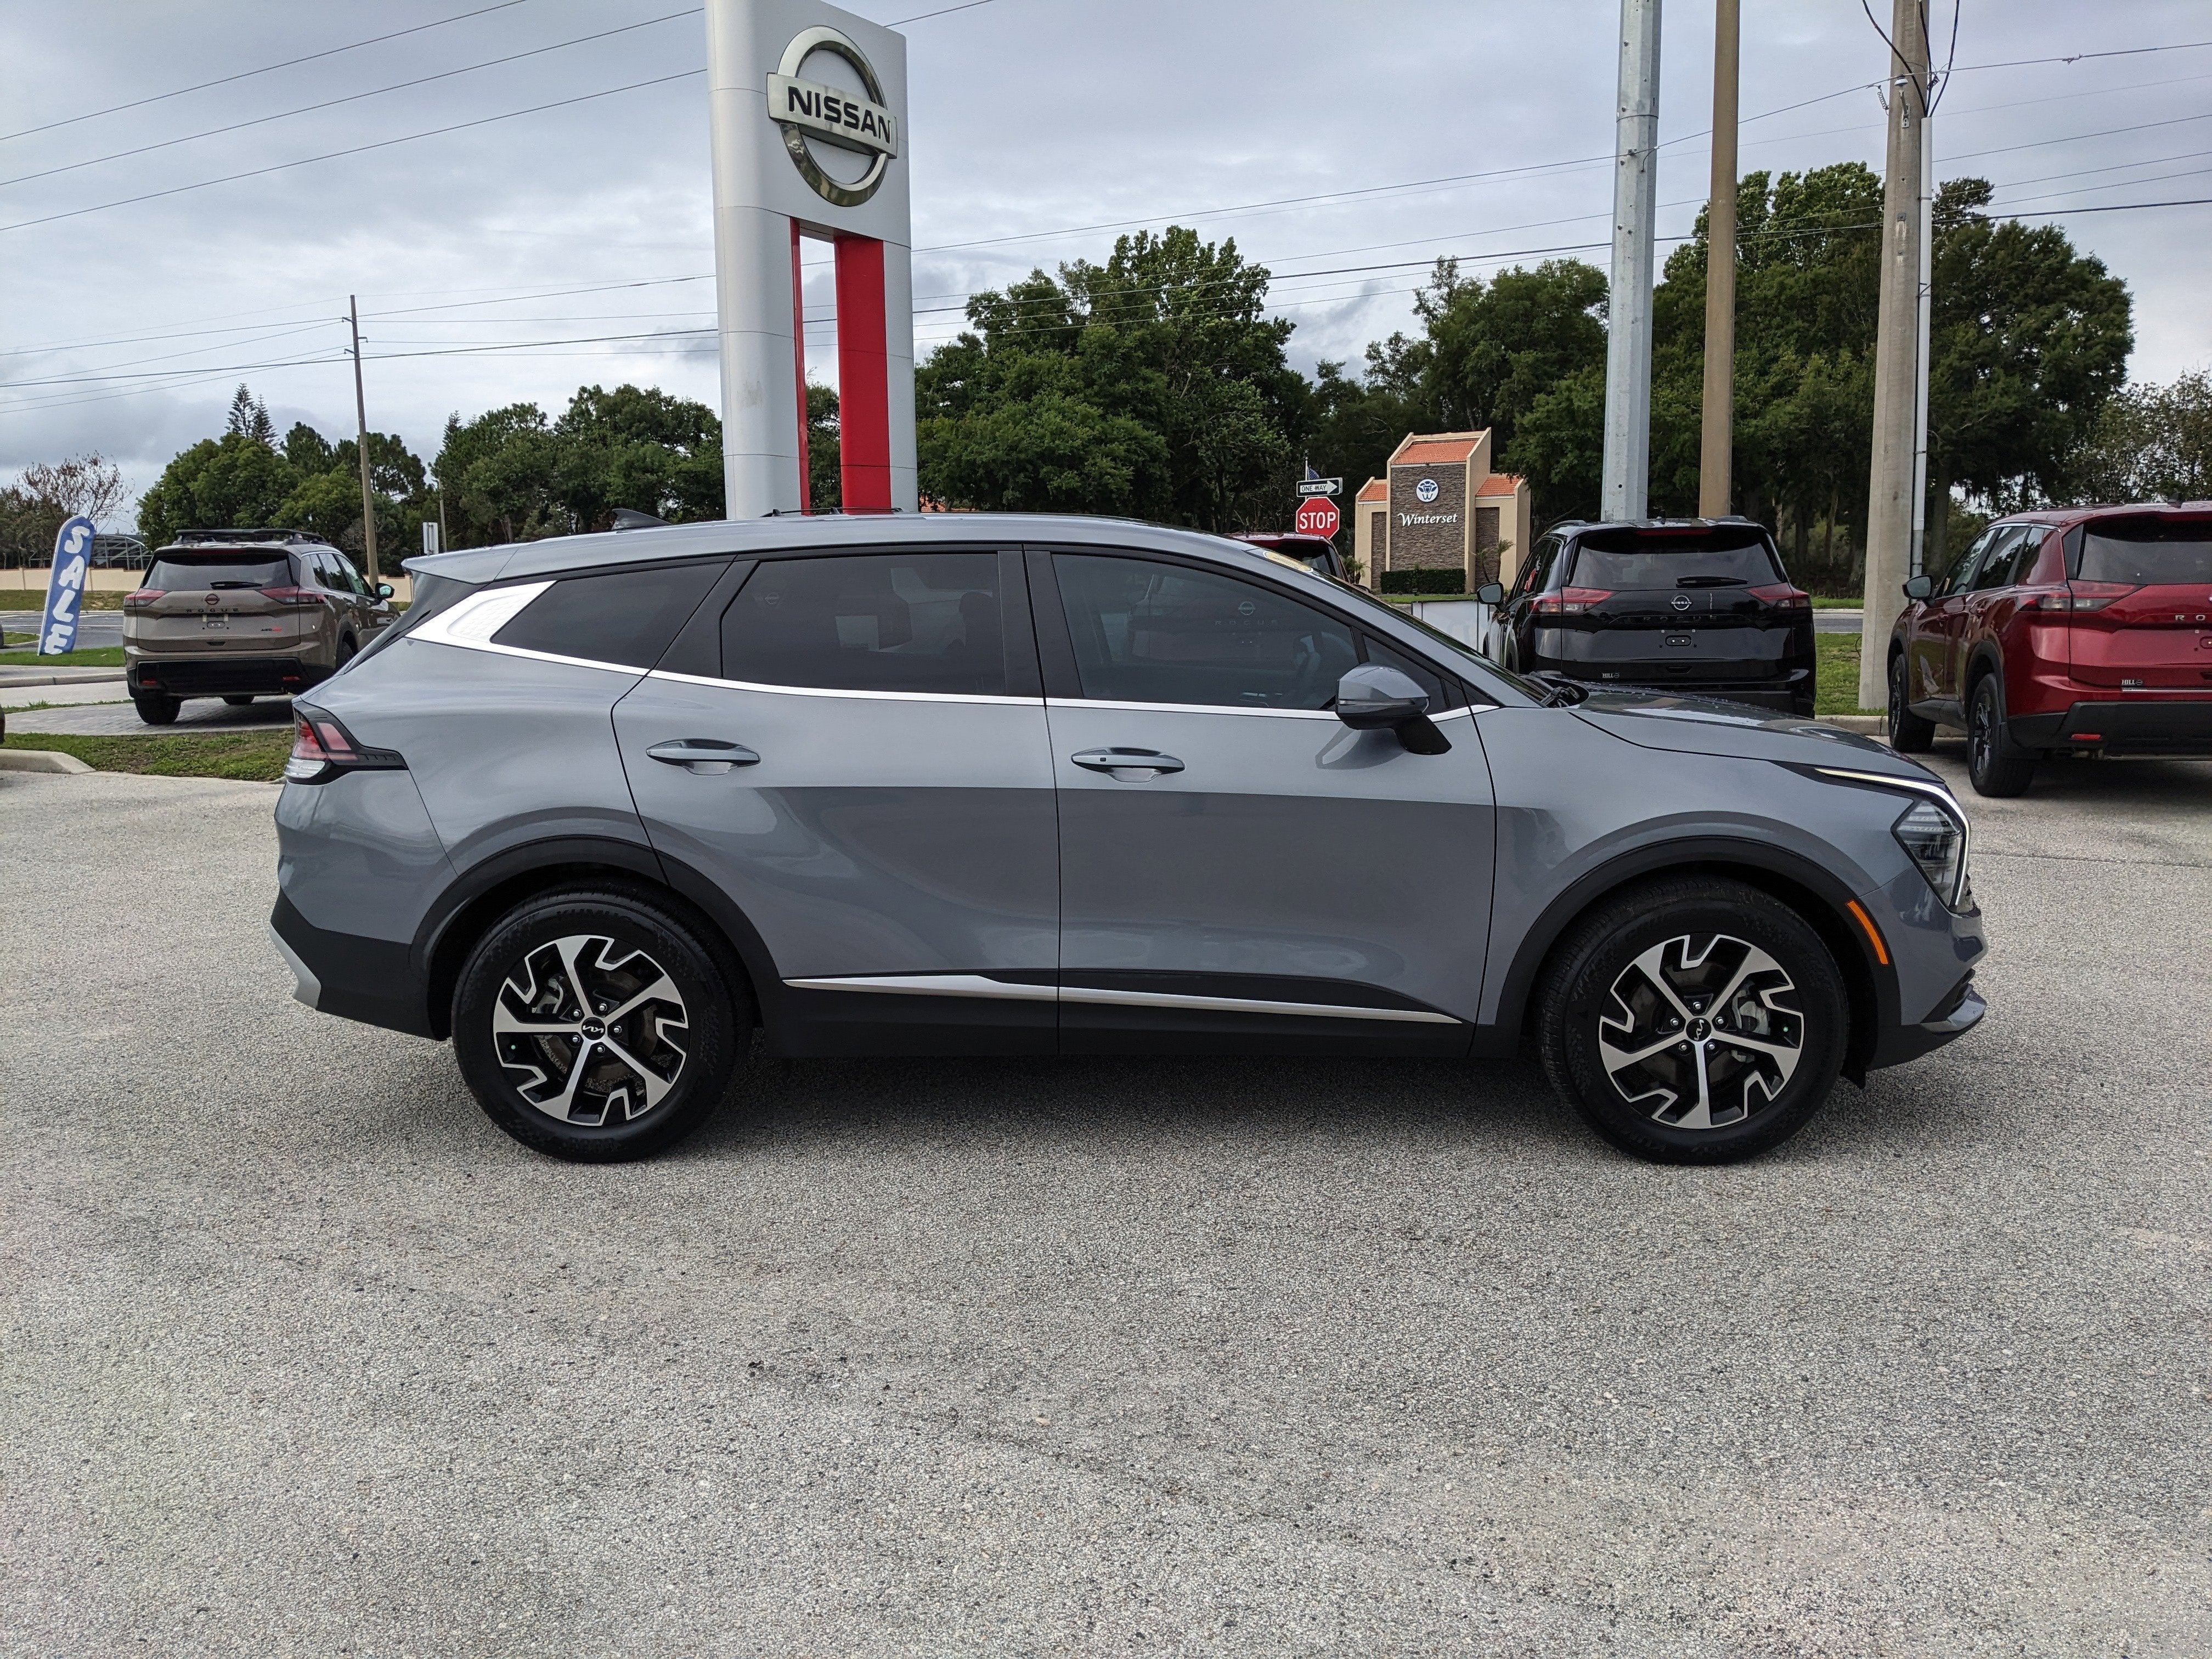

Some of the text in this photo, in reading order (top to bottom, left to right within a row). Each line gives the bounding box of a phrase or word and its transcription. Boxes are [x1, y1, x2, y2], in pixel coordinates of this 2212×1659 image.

[788, 86, 891, 144] NISSAN
[1299, 511, 1336, 529] STOP
[1397, 513, 1458, 527] Winterset
[44, 526, 91, 655] SALE
